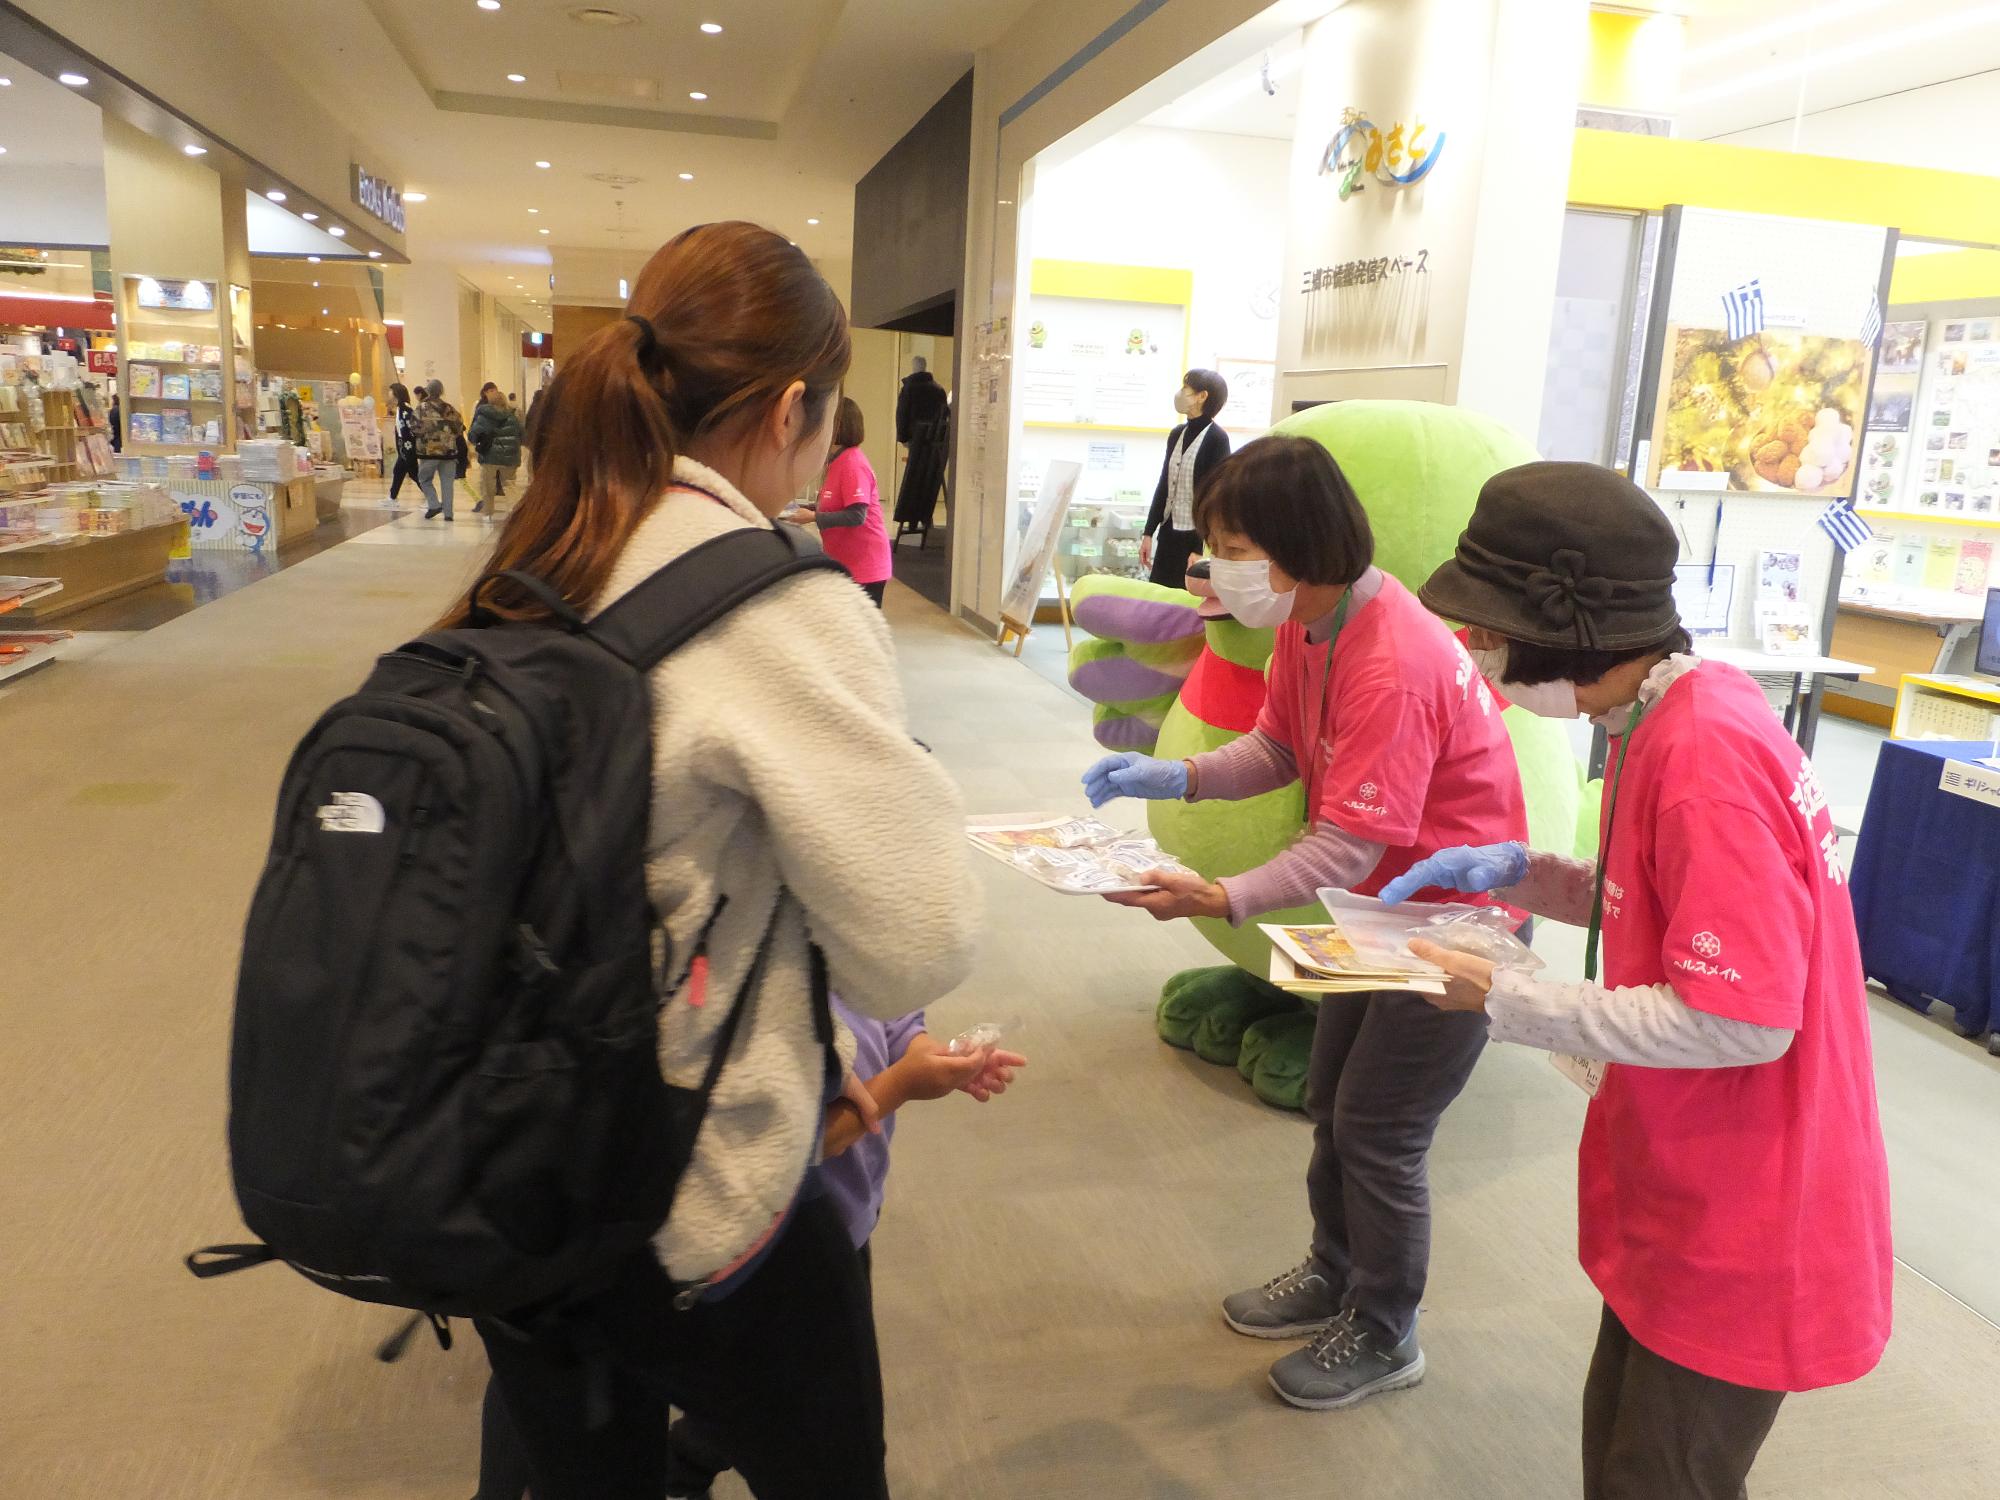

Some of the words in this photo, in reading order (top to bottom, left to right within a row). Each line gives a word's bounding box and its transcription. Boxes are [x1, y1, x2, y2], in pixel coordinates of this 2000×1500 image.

[1364, 121, 1426, 173] みさと
[1342, 800, 1388, 816] ヘルスメイト
[1673, 959, 1742, 982] ヘルスメイト
